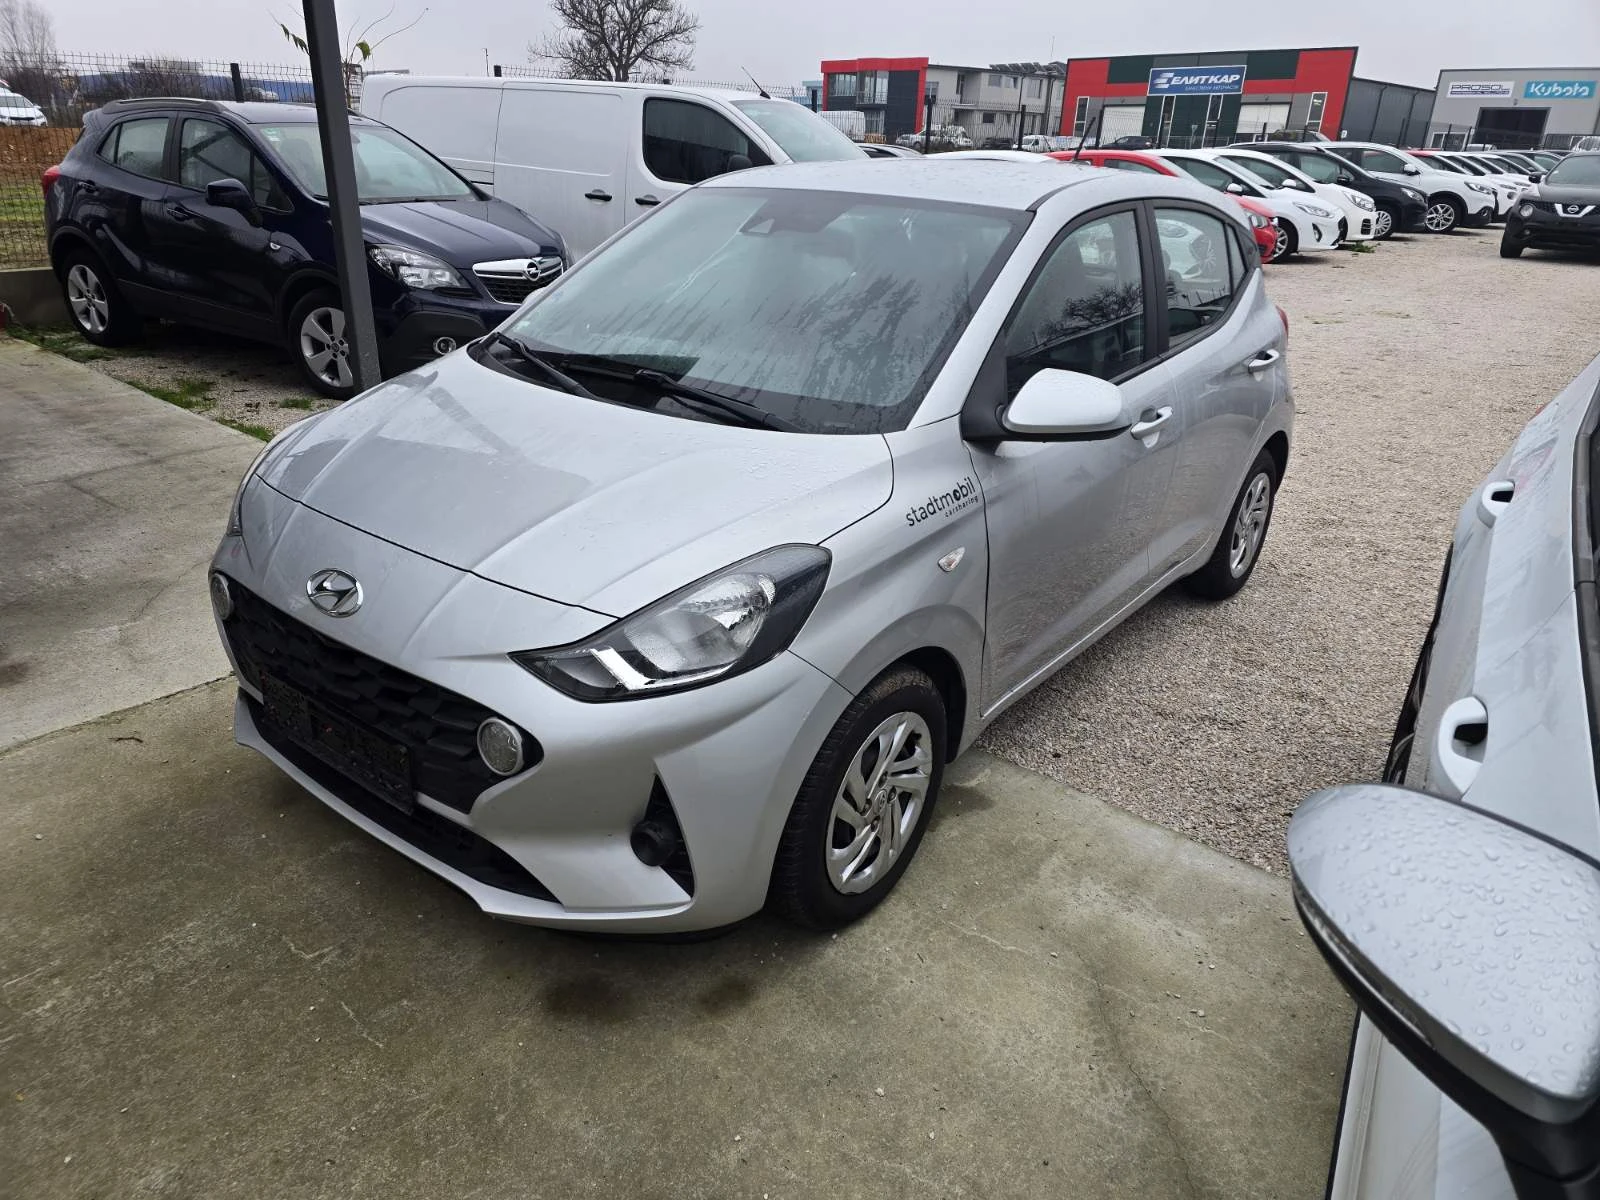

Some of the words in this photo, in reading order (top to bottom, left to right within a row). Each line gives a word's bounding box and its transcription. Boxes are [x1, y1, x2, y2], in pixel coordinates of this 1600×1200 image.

[1530, 82, 1590, 96] Kubota
[905, 476, 976, 527] stadtmobil
[944, 495, 979, 518] carsharing
